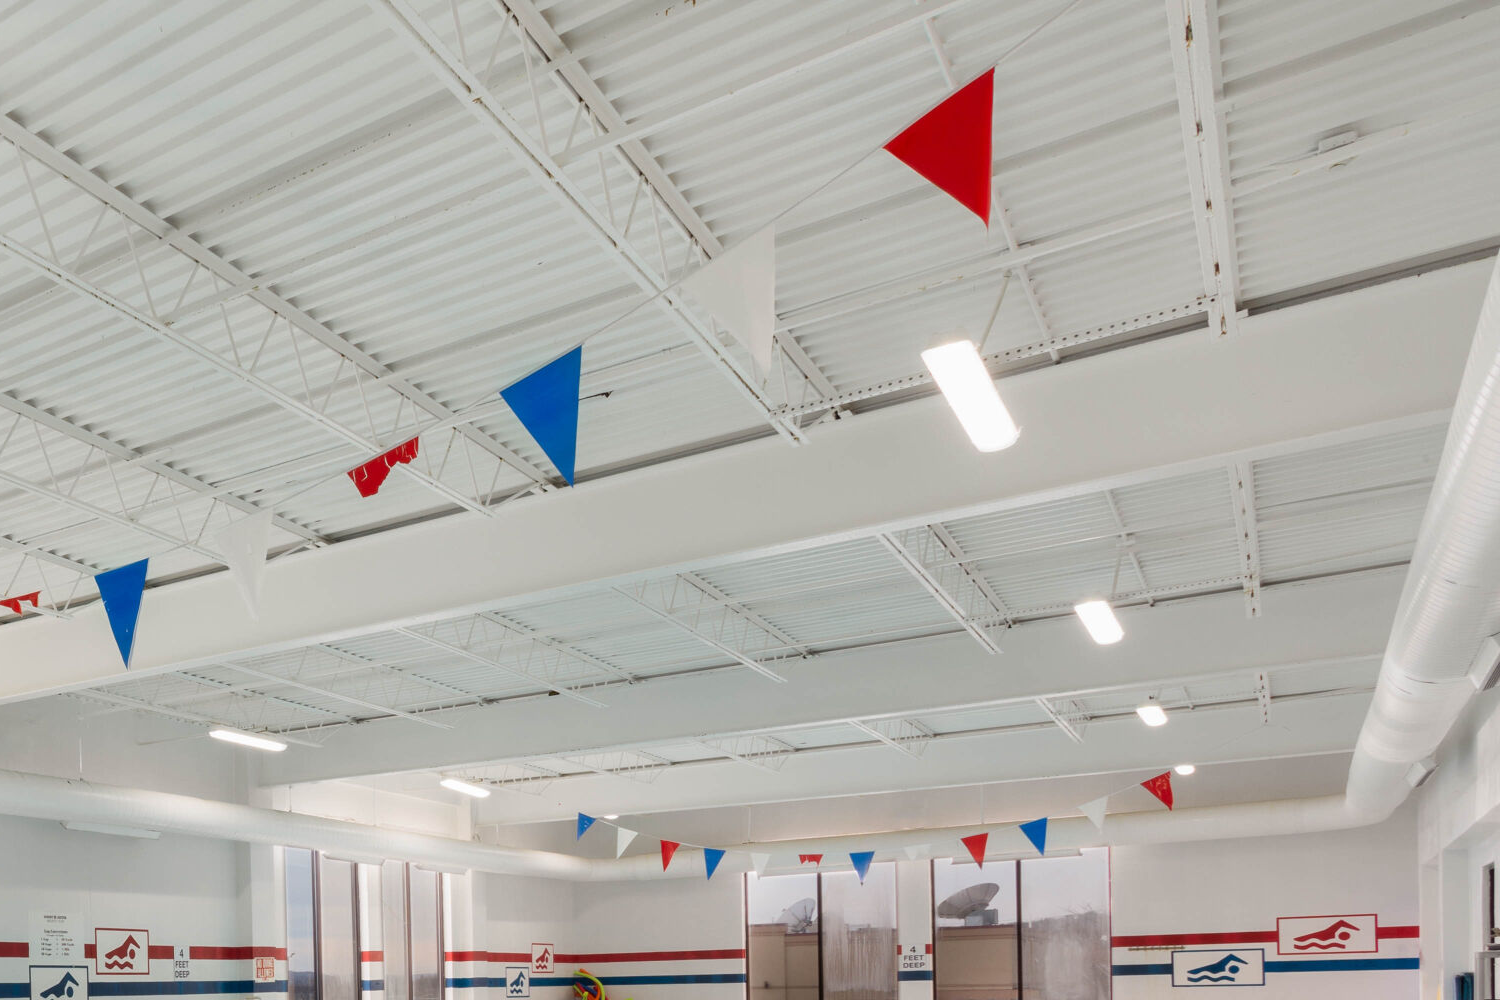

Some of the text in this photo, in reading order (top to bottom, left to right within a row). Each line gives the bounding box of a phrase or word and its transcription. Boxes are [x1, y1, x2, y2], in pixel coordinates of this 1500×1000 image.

[910, 945, 916, 953] 4
[175, 960, 189, 969] FEET
[175, 970, 190, 979] DEEP
